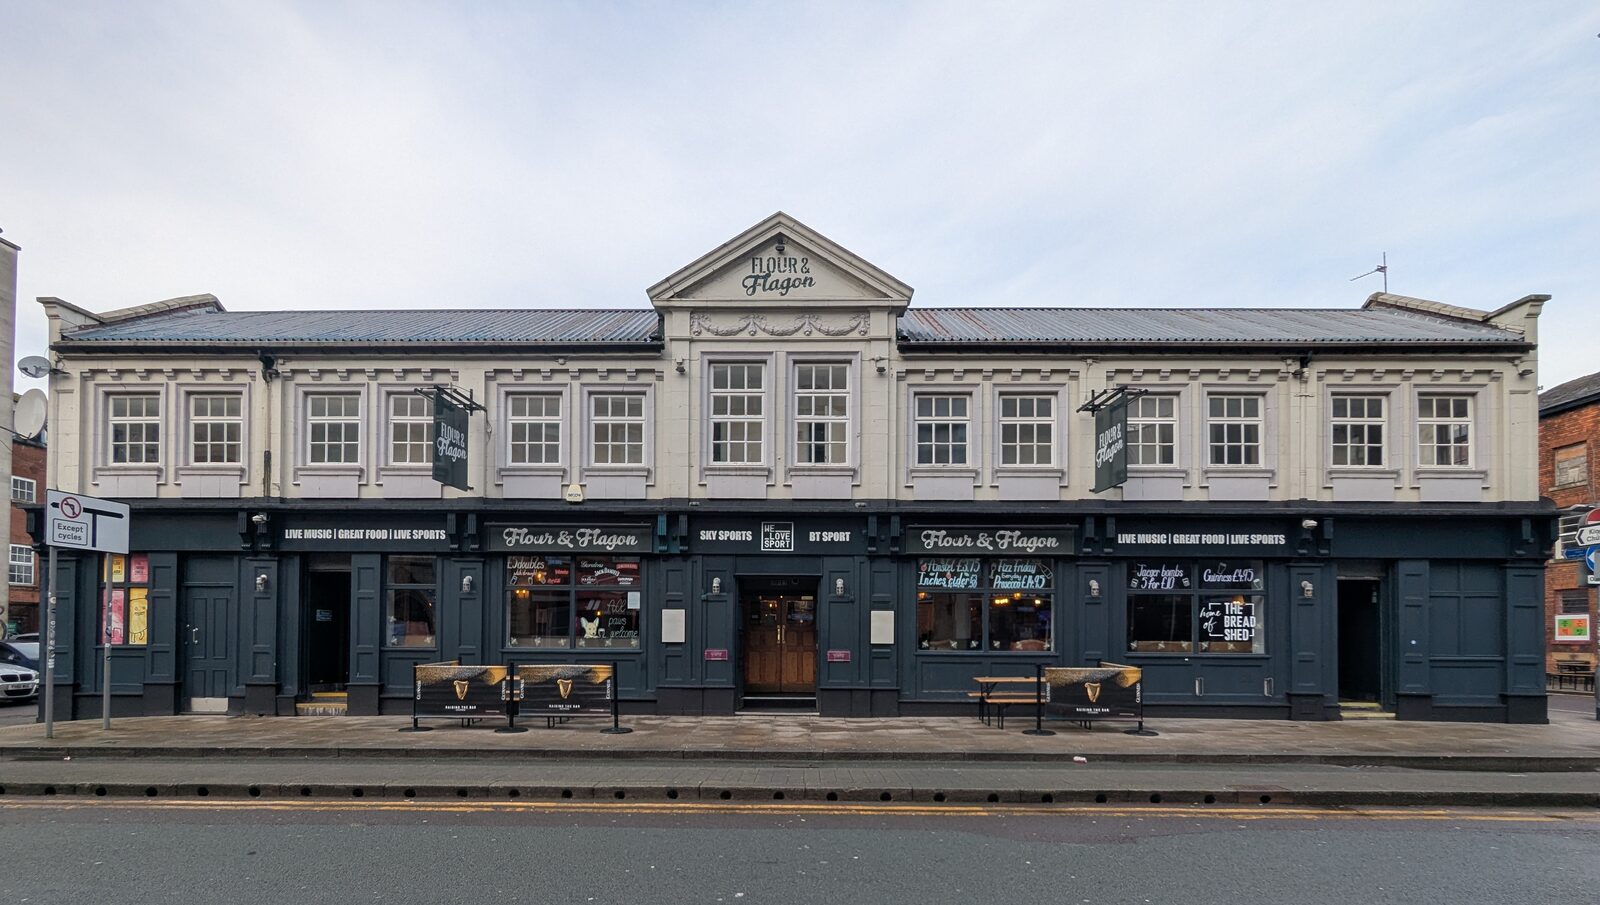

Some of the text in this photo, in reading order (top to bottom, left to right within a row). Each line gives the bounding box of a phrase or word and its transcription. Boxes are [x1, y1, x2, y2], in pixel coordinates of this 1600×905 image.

[751, 257, 811, 274] FLOUR &
[741, 273, 817, 297] Flagon
[441, 422, 460, 446] FLOUR
[1099, 425, 1117, 449] FLOUR
[436, 436, 467, 462] Flagon
[1095, 439, 1124, 469] Flagon
[57, 522, 84, 533] Except
[284, 529, 303, 539] LIVE
[303, 529, 332, 539] MUSIC
[338, 529, 365, 539] GREAT
[365, 529, 388, 539] FOOD
[393, 529, 412, 539] LIVE
[412, 529, 446, 539] SPORTS
[764, 524, 775, 533] WE
[58, 532, 82, 541] cycles
[502, 527, 638, 551] Flour & Flagon
[700, 530, 753, 541] SKY SPORTS
[769, 532, 791, 541] LOVE
[809, 531, 851, 542] BT SPORT
[920, 530, 1059, 553] Flour & Flagon
[1117, 534, 1136, 544] LIVE
[1137, 534, 1167, 544] MUSIC
[1173, 534, 1200, 544] GREAT
[1201, 534, 1225, 544] FOOD
[1230, 534, 1250, 544] LIVE
[1250, 534, 1286, 544] SPORTS
[764, 540, 791, 548] SPORT
[1136, 563, 1184, 578] Jaeger bombs
[1203, 568, 1232, 582] Guinness
[918, 571, 947, 586] Inches
[1140, 577, 1148, 589] 5
[1147, 577, 1160, 589] for
[1224, 602, 1243, 615] THE
[608, 617, 627, 627] paws
[1203, 617, 1217, 633] of
[1223, 615, 1257, 628] BREAD
[1223, 628, 1249, 641] SHED
